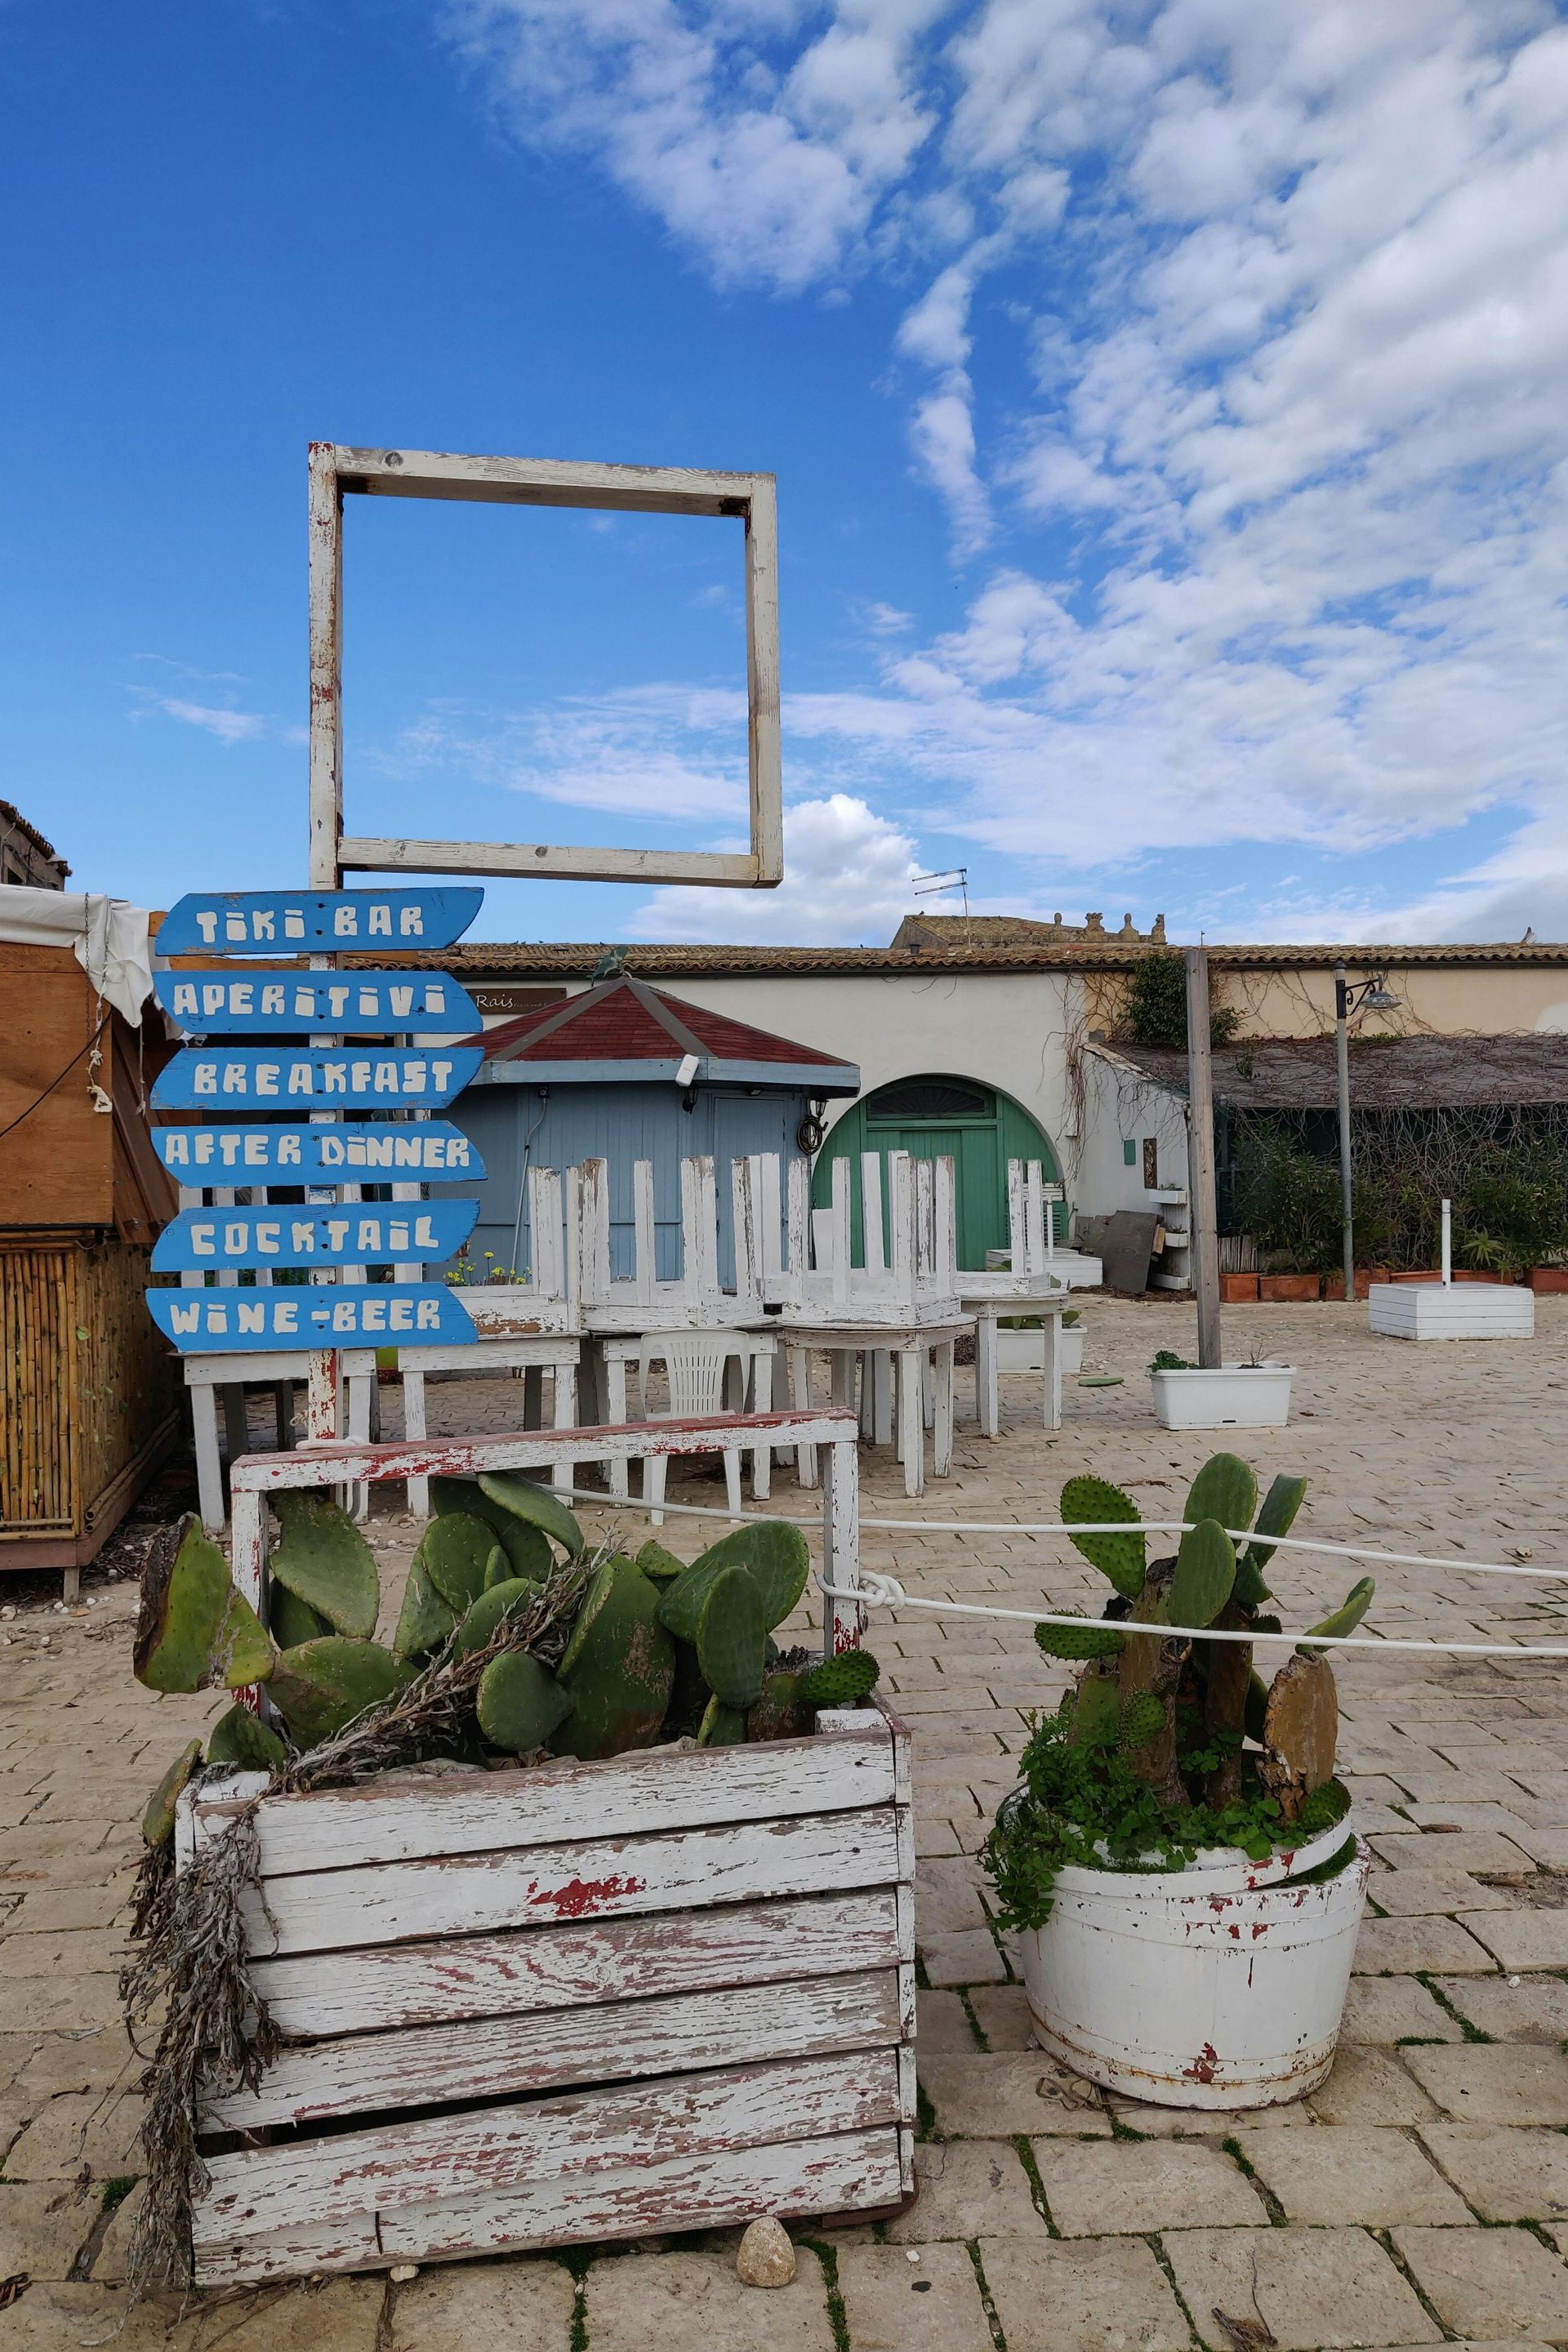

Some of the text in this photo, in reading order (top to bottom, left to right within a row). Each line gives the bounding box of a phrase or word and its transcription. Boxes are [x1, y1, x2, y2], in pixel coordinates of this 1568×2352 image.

[334, 905, 424, 936] BAR
[476, 995, 514, 1009] Rais
[194, 1062, 452, 1096] BREAKFAST
[165, 1134, 301, 1165] AFTER
